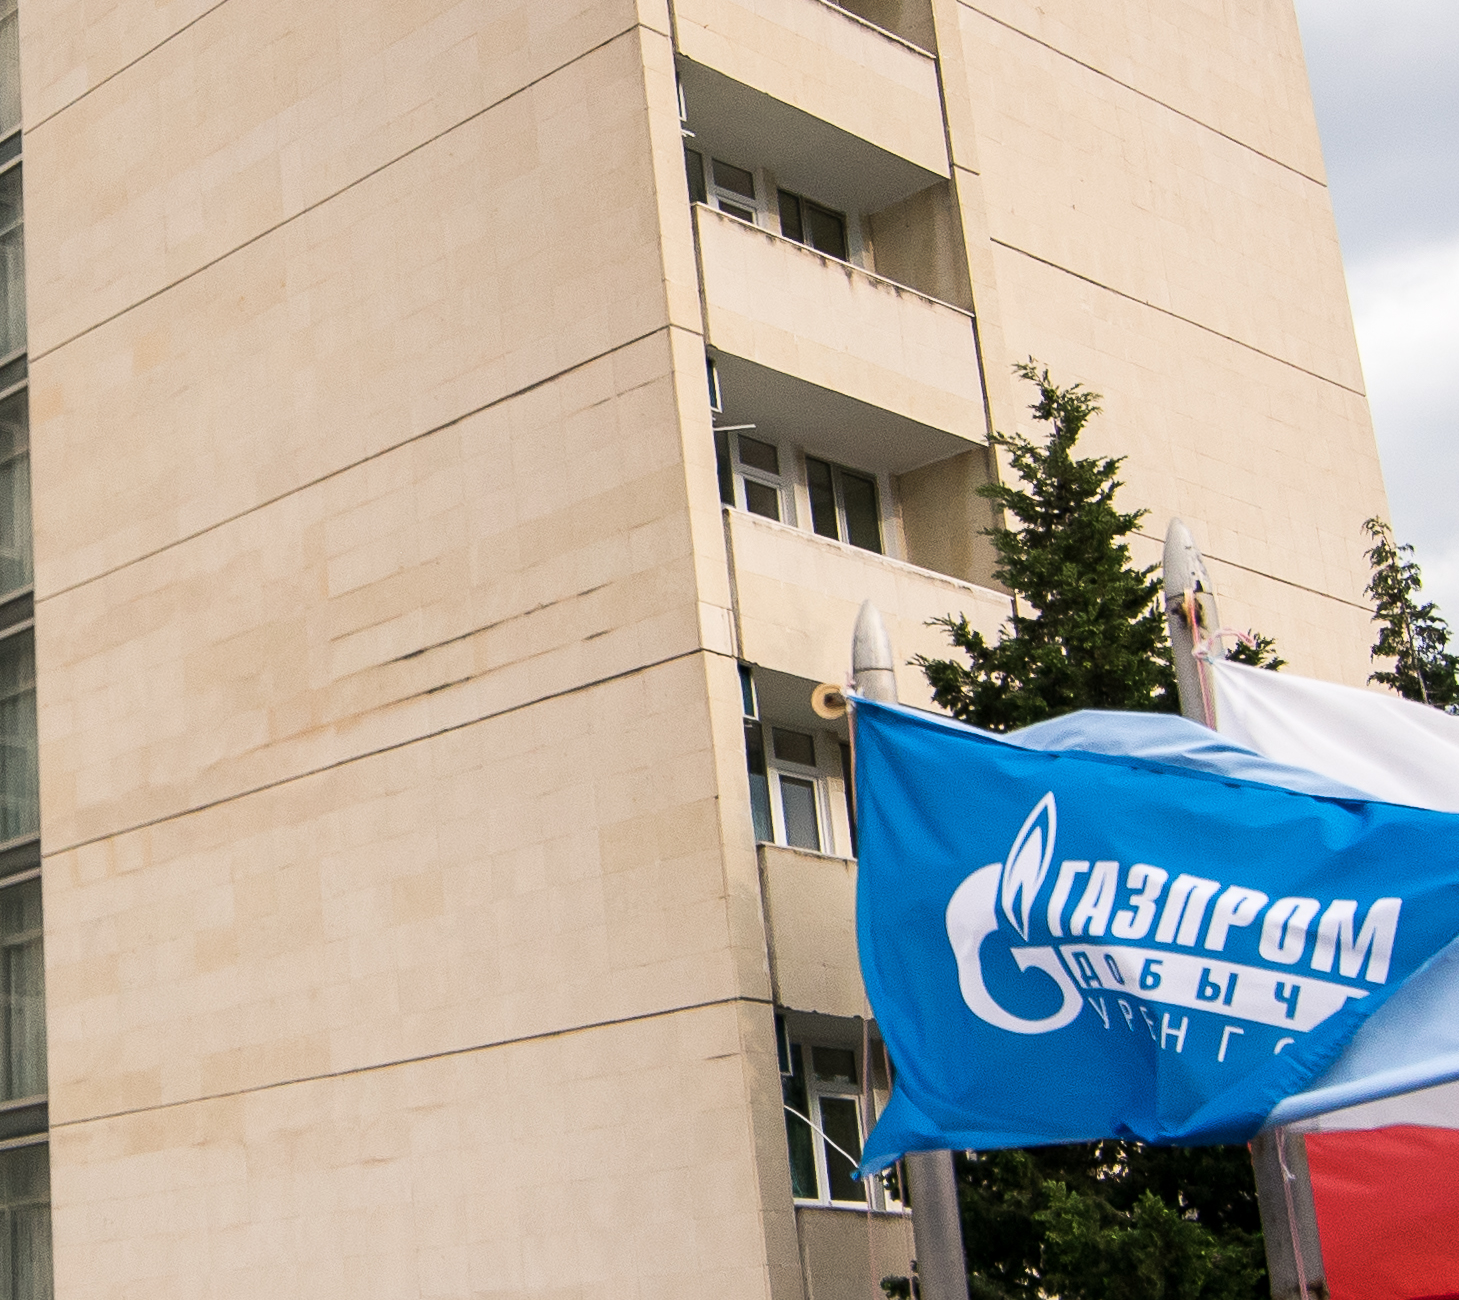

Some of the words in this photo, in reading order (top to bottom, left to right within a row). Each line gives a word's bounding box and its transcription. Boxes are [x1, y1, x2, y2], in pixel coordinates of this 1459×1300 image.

[1047, 860, 1403, 985] ГАЗПРОМ
[1072, 951, 1303, 1021] ДОБЫЧ
[1087, 996, 1297, 1055] УРЕНГ
